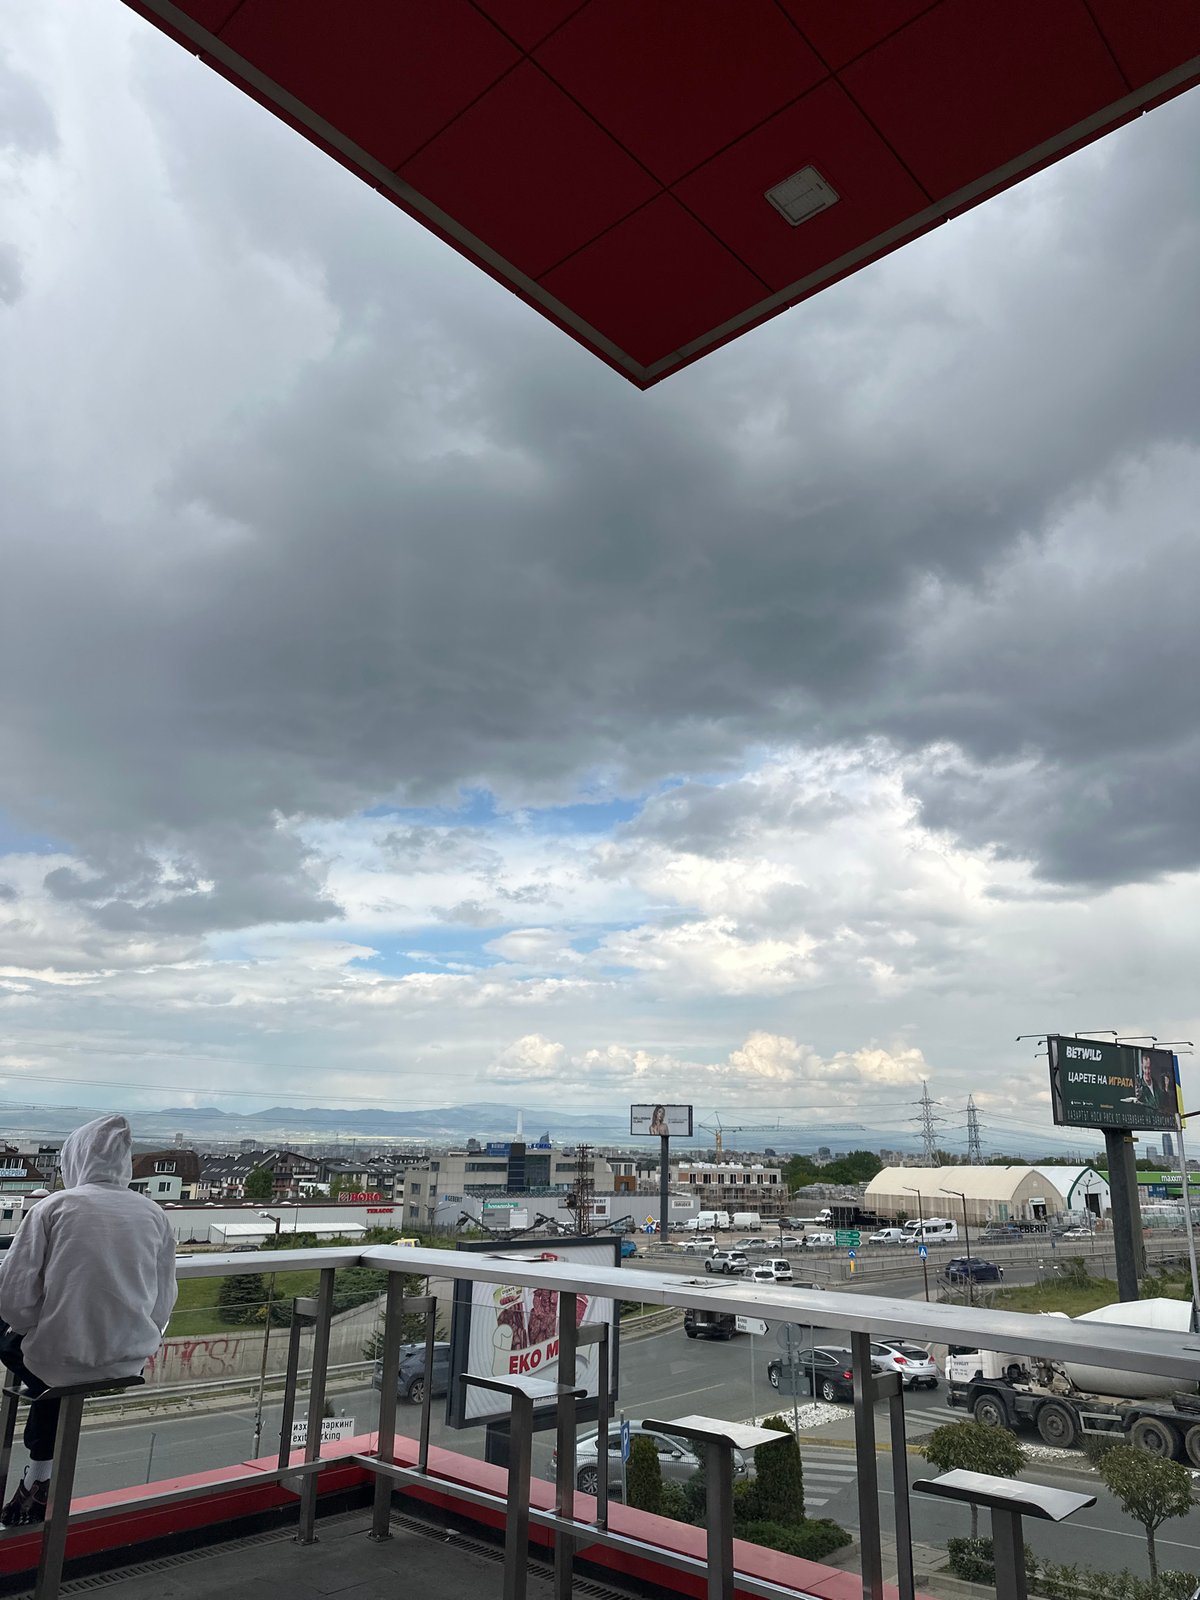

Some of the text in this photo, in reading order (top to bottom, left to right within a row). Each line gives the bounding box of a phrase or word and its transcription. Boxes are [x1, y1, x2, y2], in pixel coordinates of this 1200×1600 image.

[1068, 1071, 1134, 1088] ЦАРЕТЕ НА ИГРАТА
[1161, 1174, 1193, 1182] maxxmt
[321, 1431, 341, 1441] rking
